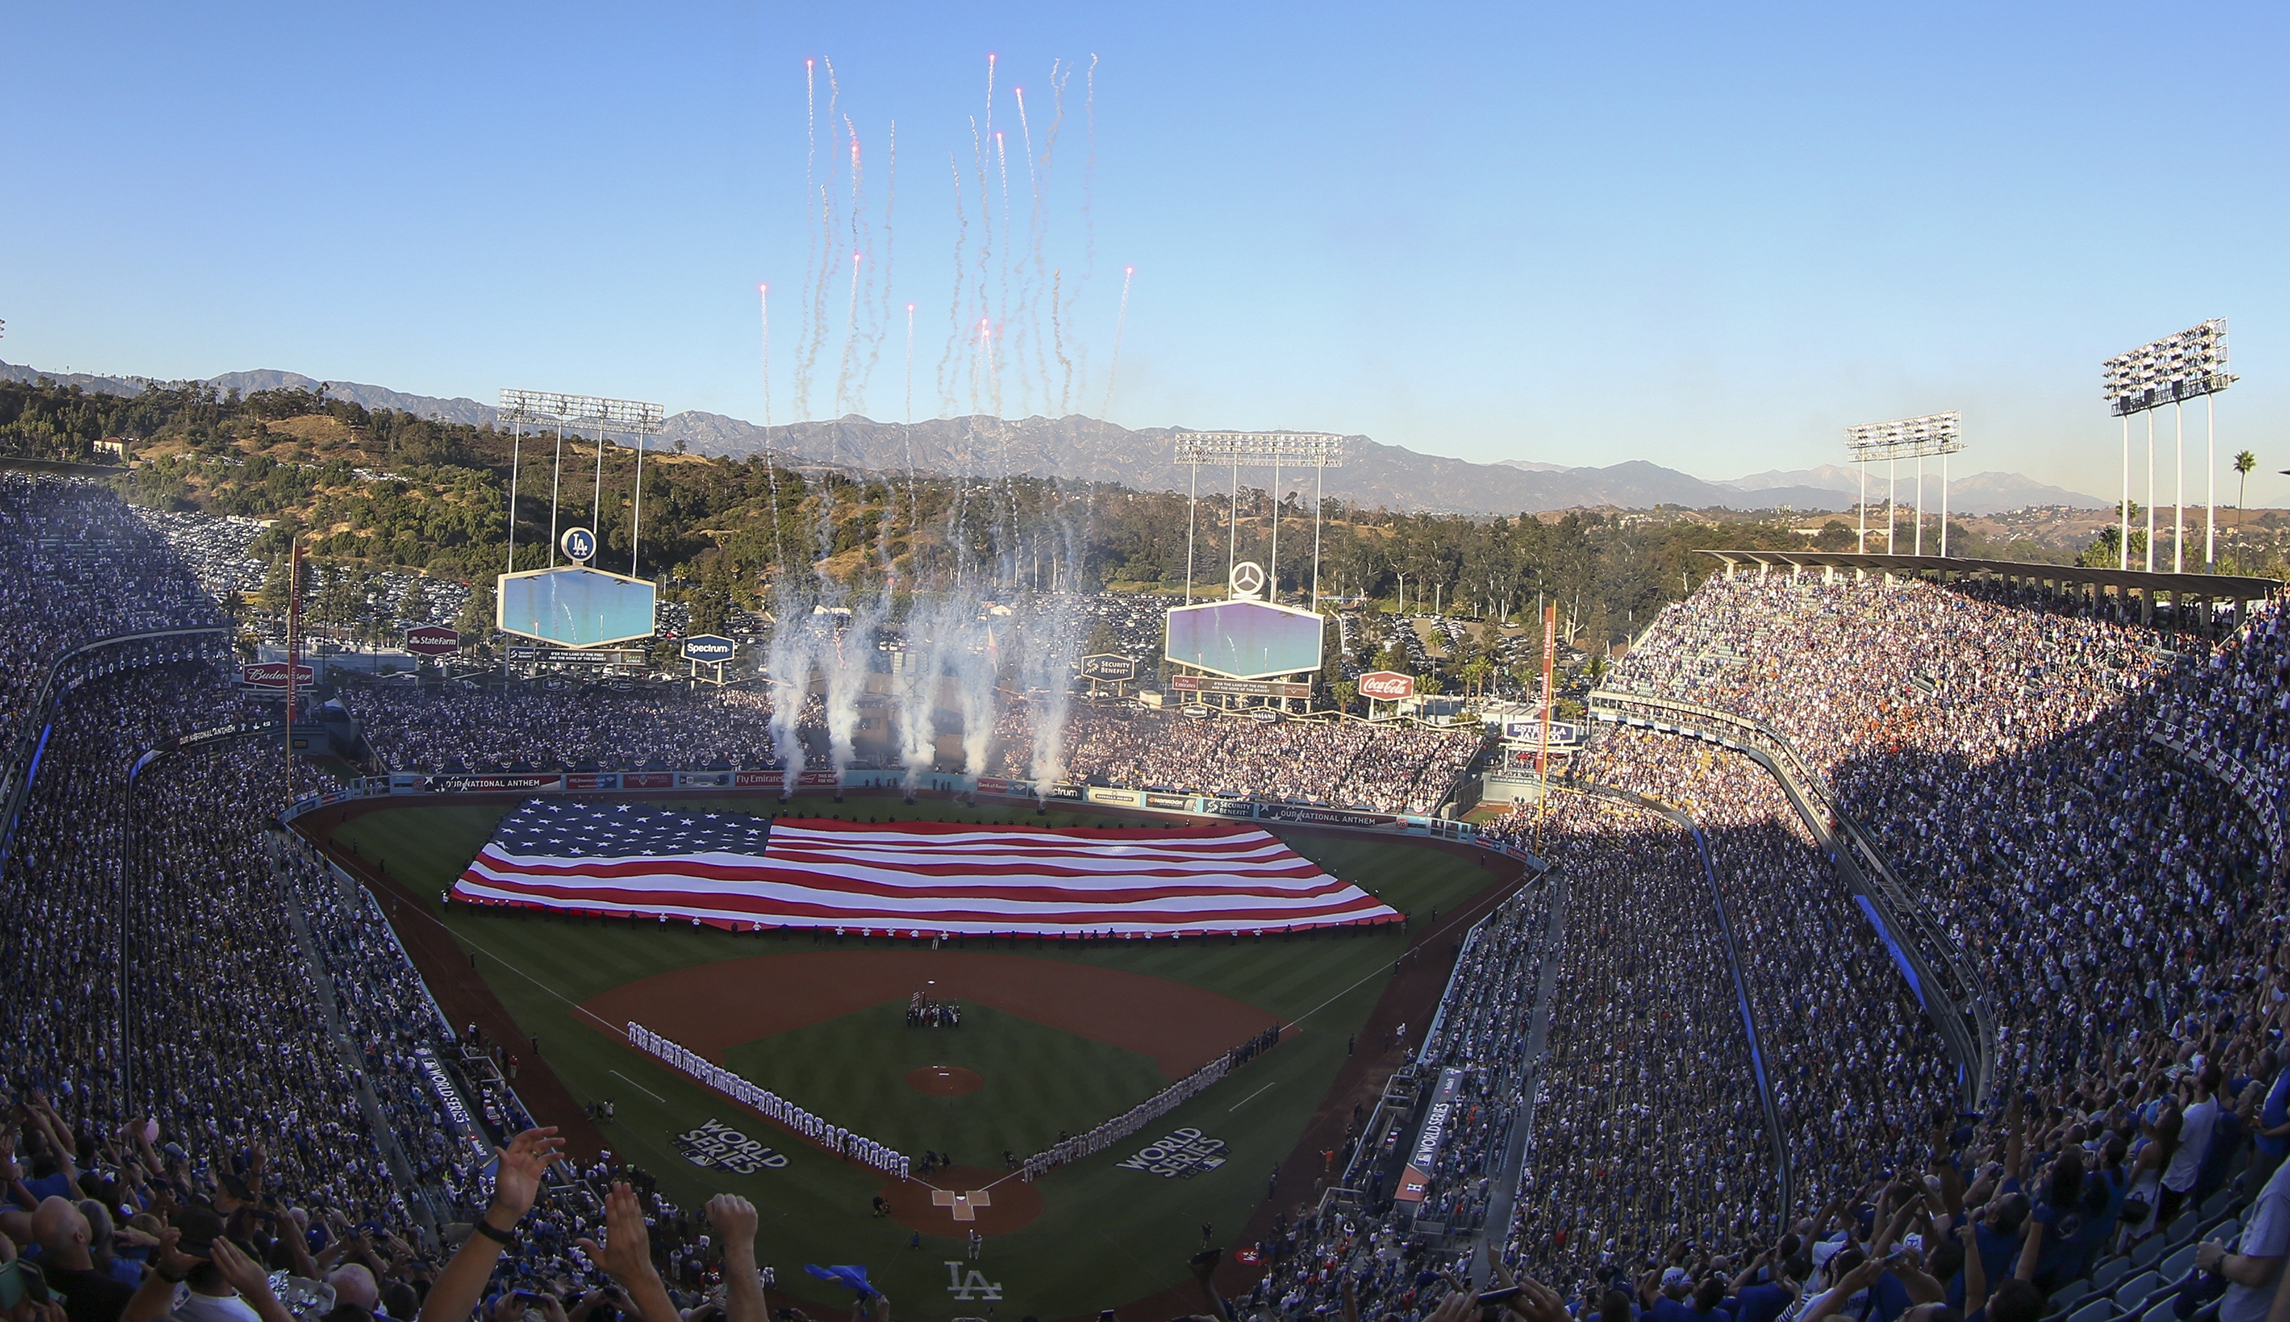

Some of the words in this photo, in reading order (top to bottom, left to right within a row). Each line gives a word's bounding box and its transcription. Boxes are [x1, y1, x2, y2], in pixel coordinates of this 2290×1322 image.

[573, 533, 588, 556] LA
[687, 643, 728, 654] Spectrum
[1101, 660, 1130, 668] SECURITY
[247, 668, 312, 681] Budwser
[1363, 677, 1408, 694] Coca-Cola
[1541, 672, 1549, 698] Emirates
[212, 725, 236, 736] ANTHEM
[1513, 724, 1567, 735] ESTRLA
[1518, 732, 1561, 741] JALCO
[736, 775, 749, 784] Fly
[750, 774, 784, 783] Emirates
[1220, 801, 1250, 809] SECURITY
[1280, 809, 1297, 818] OUR
[1299, 810, 1340, 822] NATIONAL
[1342, 816, 1376, 825] ANTHEM
[428, 1067, 454, 1098] WORLD
[1428, 1103, 1449, 1126] SERIES
[700, 1118, 790, 1168] WORLD
[1115, 1127, 1202, 1170] WORLD
[1418, 1125, 1441, 1153] WORLD
[678, 1130, 762, 1174] SERIES
[1149, 1136, 1225, 1178] SERIES
[944, 1261, 1003, 1300] LA
